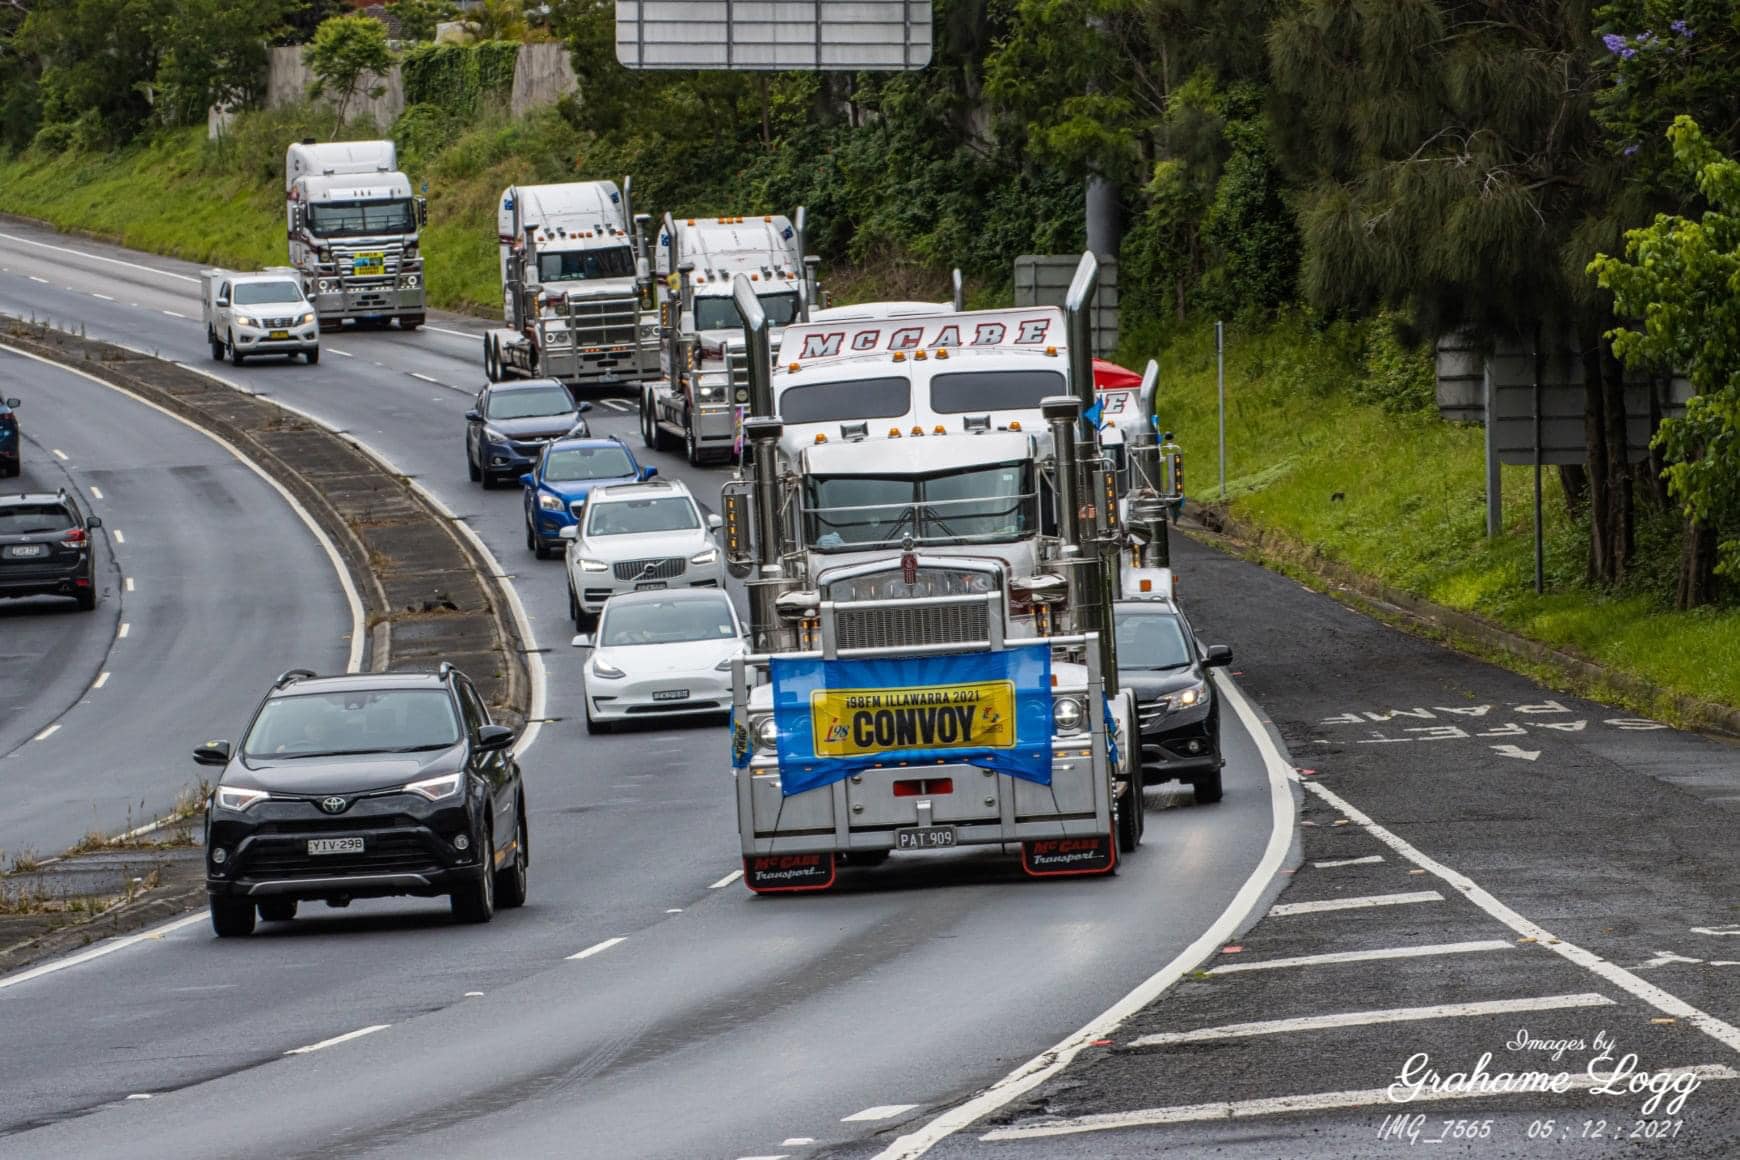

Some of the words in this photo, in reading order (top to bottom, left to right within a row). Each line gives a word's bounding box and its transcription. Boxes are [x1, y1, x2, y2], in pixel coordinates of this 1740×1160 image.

[885, 692, 950, 707] ILLAWARRA
[953, 689, 980, 703] 2021
[853, 704, 977, 747] CONVOY
[900, 833, 925, 847] PAT
[930, 831, 951, 845] 909
[1033, 850, 1094, 864] Transport
[755, 866, 816, 880] Transport
